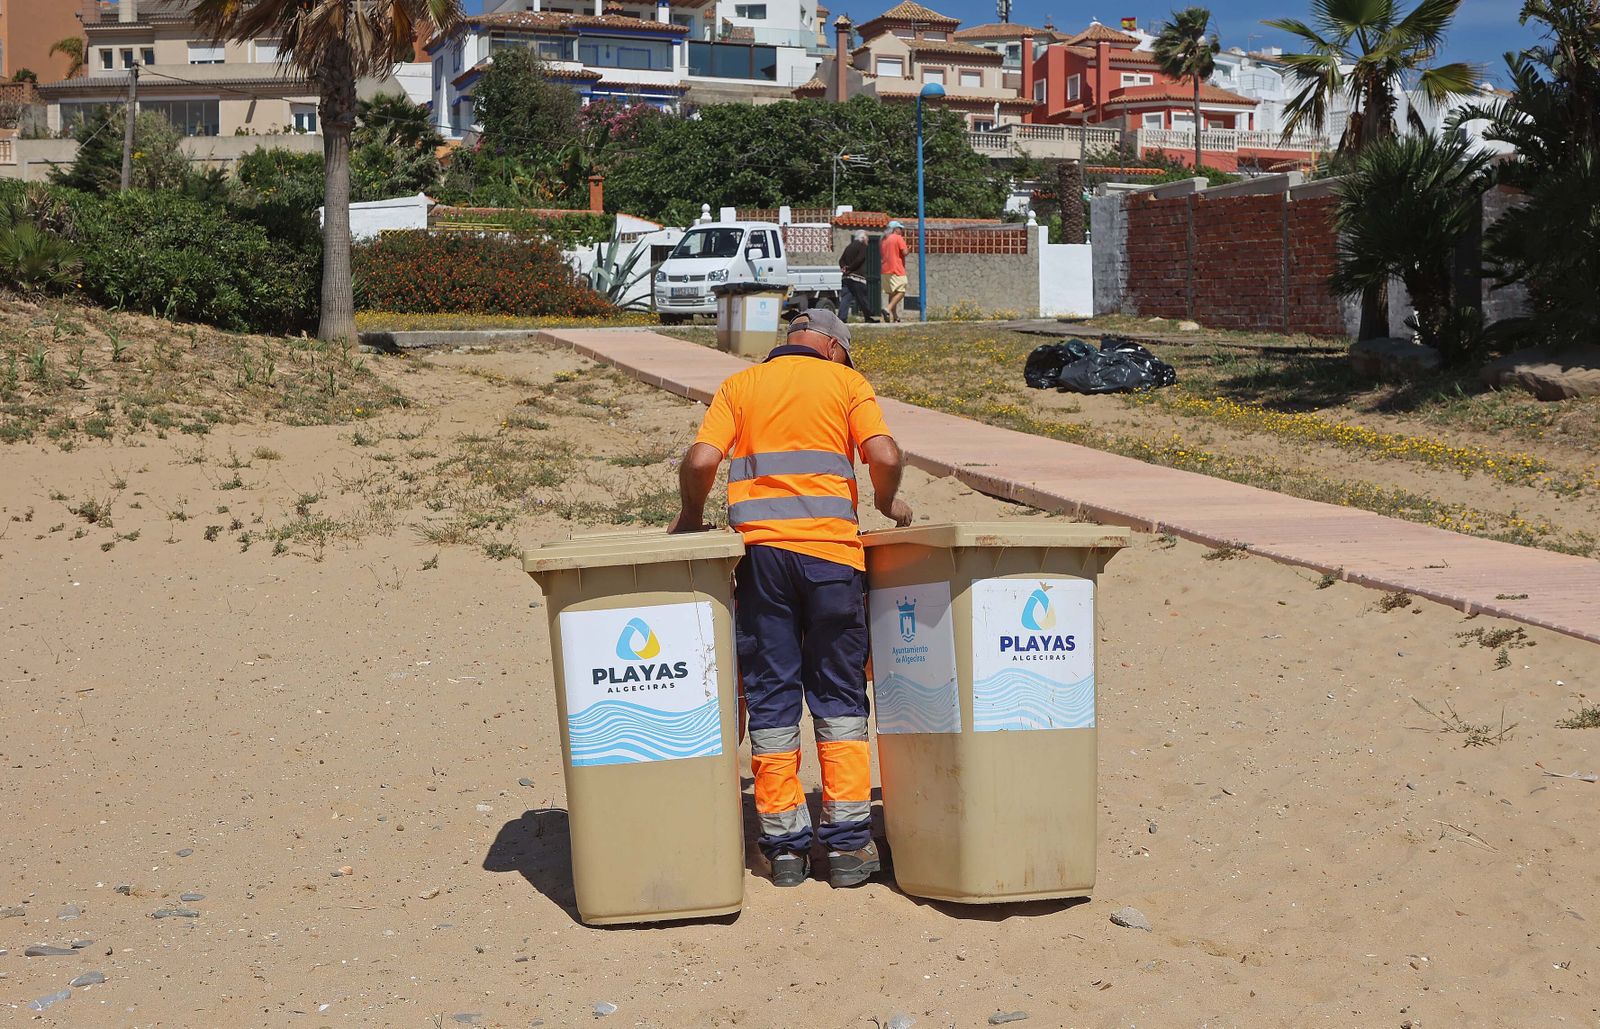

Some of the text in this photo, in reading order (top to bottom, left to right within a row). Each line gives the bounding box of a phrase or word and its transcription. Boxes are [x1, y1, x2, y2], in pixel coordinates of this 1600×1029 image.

[999, 635, 1076, 652] PLAYAS
[891, 646, 929, 656] Ayuntamiento
[902, 654, 926, 664] Algeciras
[592, 661, 689, 685] PLAYAS
[607, 682, 676, 693] ALGECIRAS
